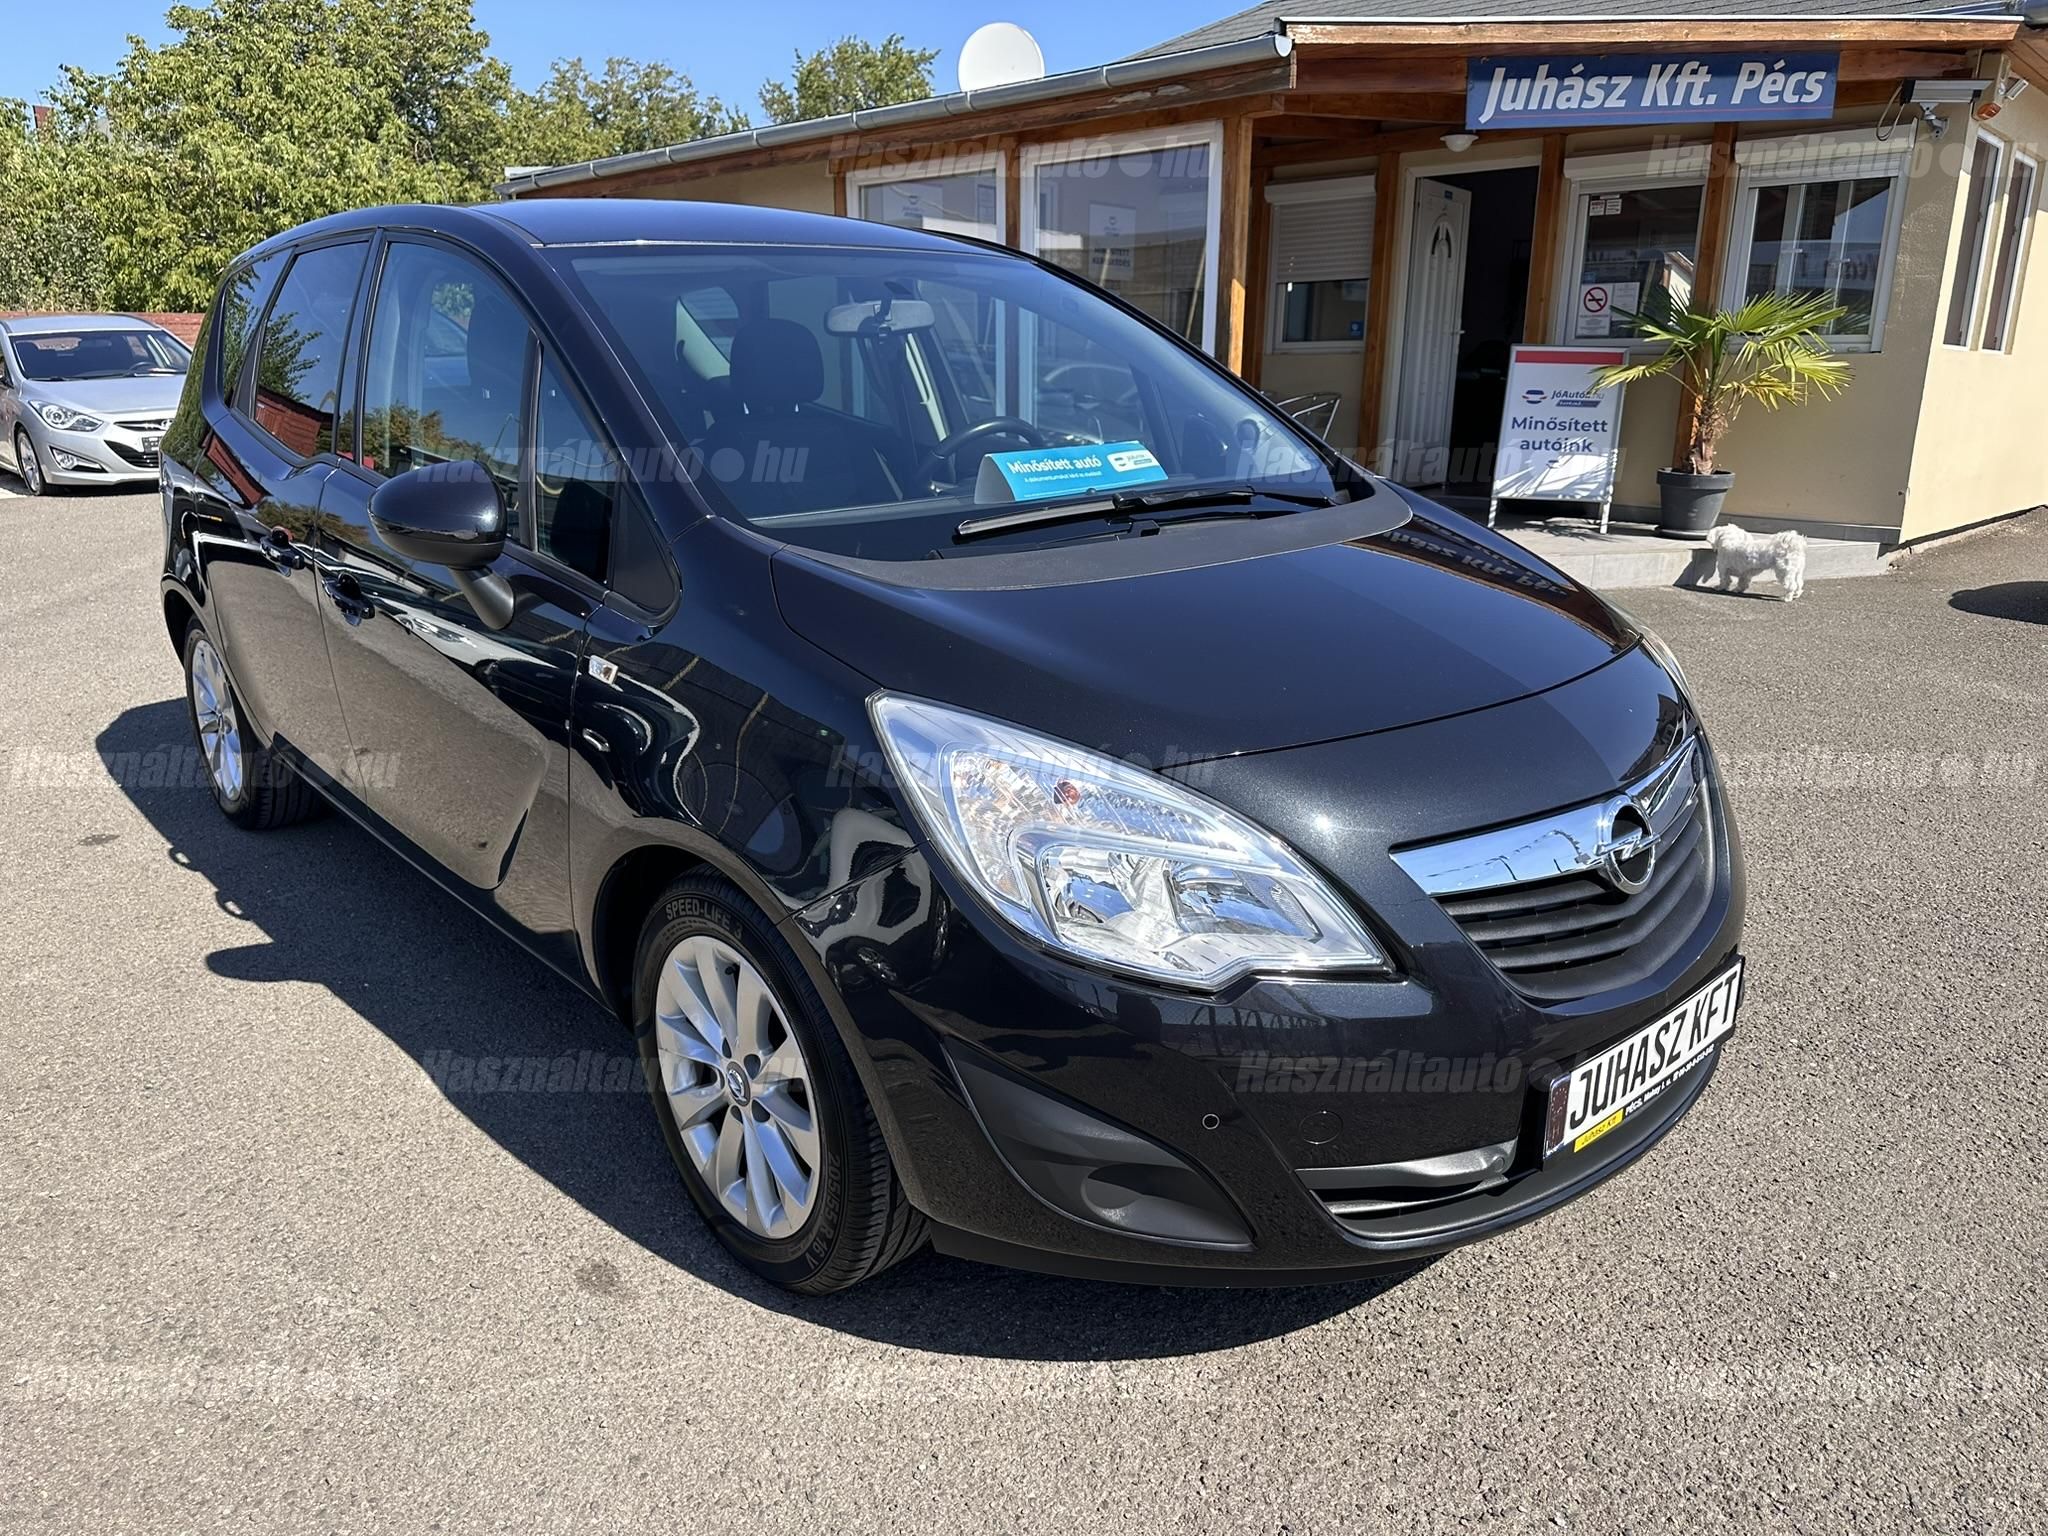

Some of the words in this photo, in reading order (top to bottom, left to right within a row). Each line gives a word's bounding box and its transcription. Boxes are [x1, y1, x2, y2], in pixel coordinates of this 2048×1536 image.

[1478, 63, 1633, 125] Juhász
[1640, 61, 1717, 107] Kft.
[1730, 59, 1827, 105] Pécs
[1511, 416, 1608, 432] Minősített
[1520, 438, 1593, 453] autóink
[1008, 456, 1074, 474] Minősített
[1075, 454, 1102, 468] autó
[665, 899, 731, 930] SPEED-LIFE
[1570, 1009, 1688, 1130] JUHASZ
[1688, 970, 1739, 1052] KFT
